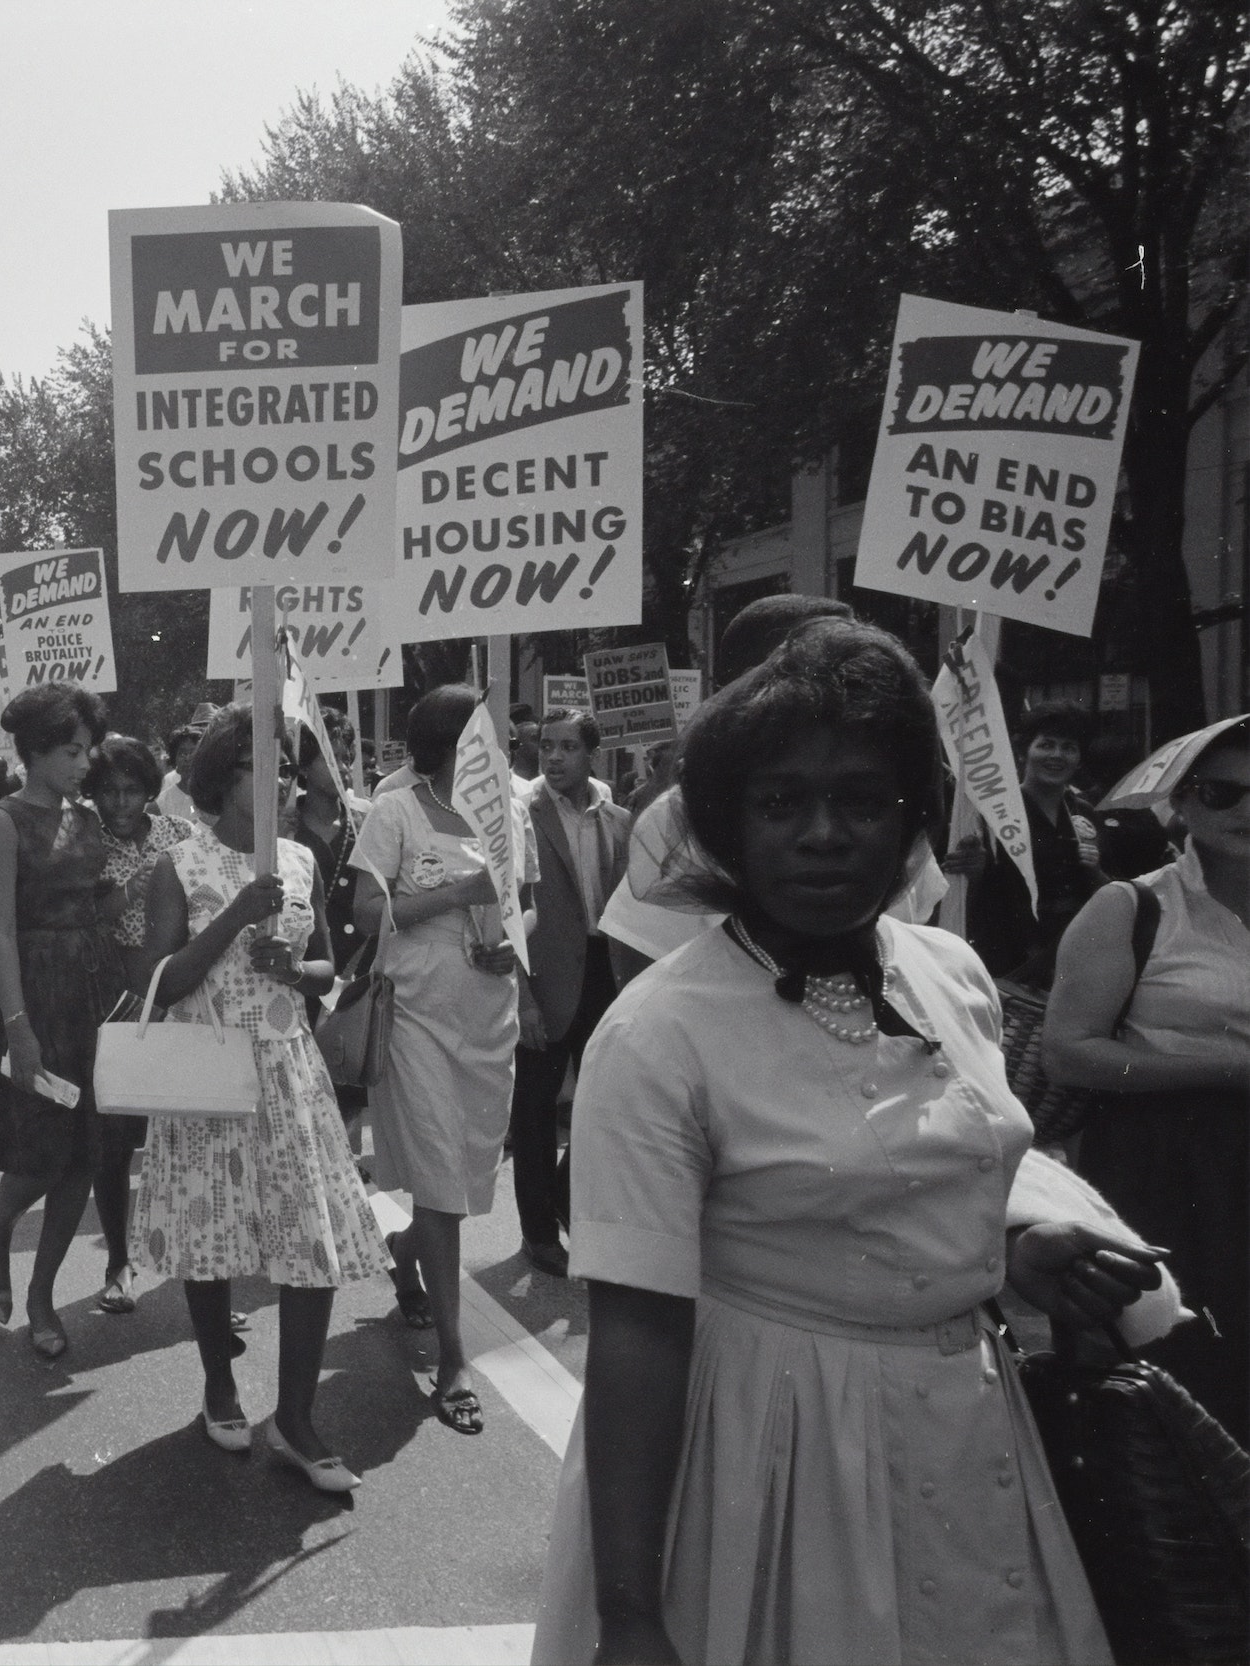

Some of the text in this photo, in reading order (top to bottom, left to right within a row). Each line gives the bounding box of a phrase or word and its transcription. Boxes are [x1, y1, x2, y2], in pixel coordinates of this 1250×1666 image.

[220, 239, 294, 277] WE
[152, 282, 361, 335] MARCH
[219, 338, 300, 362] FOR
[460, 316, 549, 383] WE
[971, 341, 1058, 379] WE
[136, 381, 379, 431] INTEGRATED
[400, 346, 623, 455] DEMAND
[905, 381, 1114, 426] DEMAND
[137, 441, 376, 490] SCHOOLS
[421, 451, 608, 505] DECENT
[904, 442, 1096, 508] AN END
[156, 493, 366, 564] NOW!
[403, 506, 626, 560] HOUSING
[905, 484, 1086, 552] TO BIAS
[34, 558, 69, 584] WE
[418, 544, 616, 616] NOW!
[897, 531, 1081, 601] NOW!
[11, 572, 97, 615] DEMAND
[239, 585, 364, 613] RGHTS
[20, 613, 93, 630] AN END
[37, 633, 83, 648] POLICE
[25, 646, 92, 662] BRUTALITY
[26, 654, 105, 685] NOW!
[593, 650, 656, 668] UAW SAYS
[551, 689, 589, 699] MARCH
[592, 666, 664, 688] JOBS and
[594, 684, 668, 711] FREEDOM
[623, 710, 645, 718] FOR
[627, 717, 672, 733] American
[961, 659, 1028, 857] FREEDOM IN '63
[454, 733, 510, 870] FREEDOM
